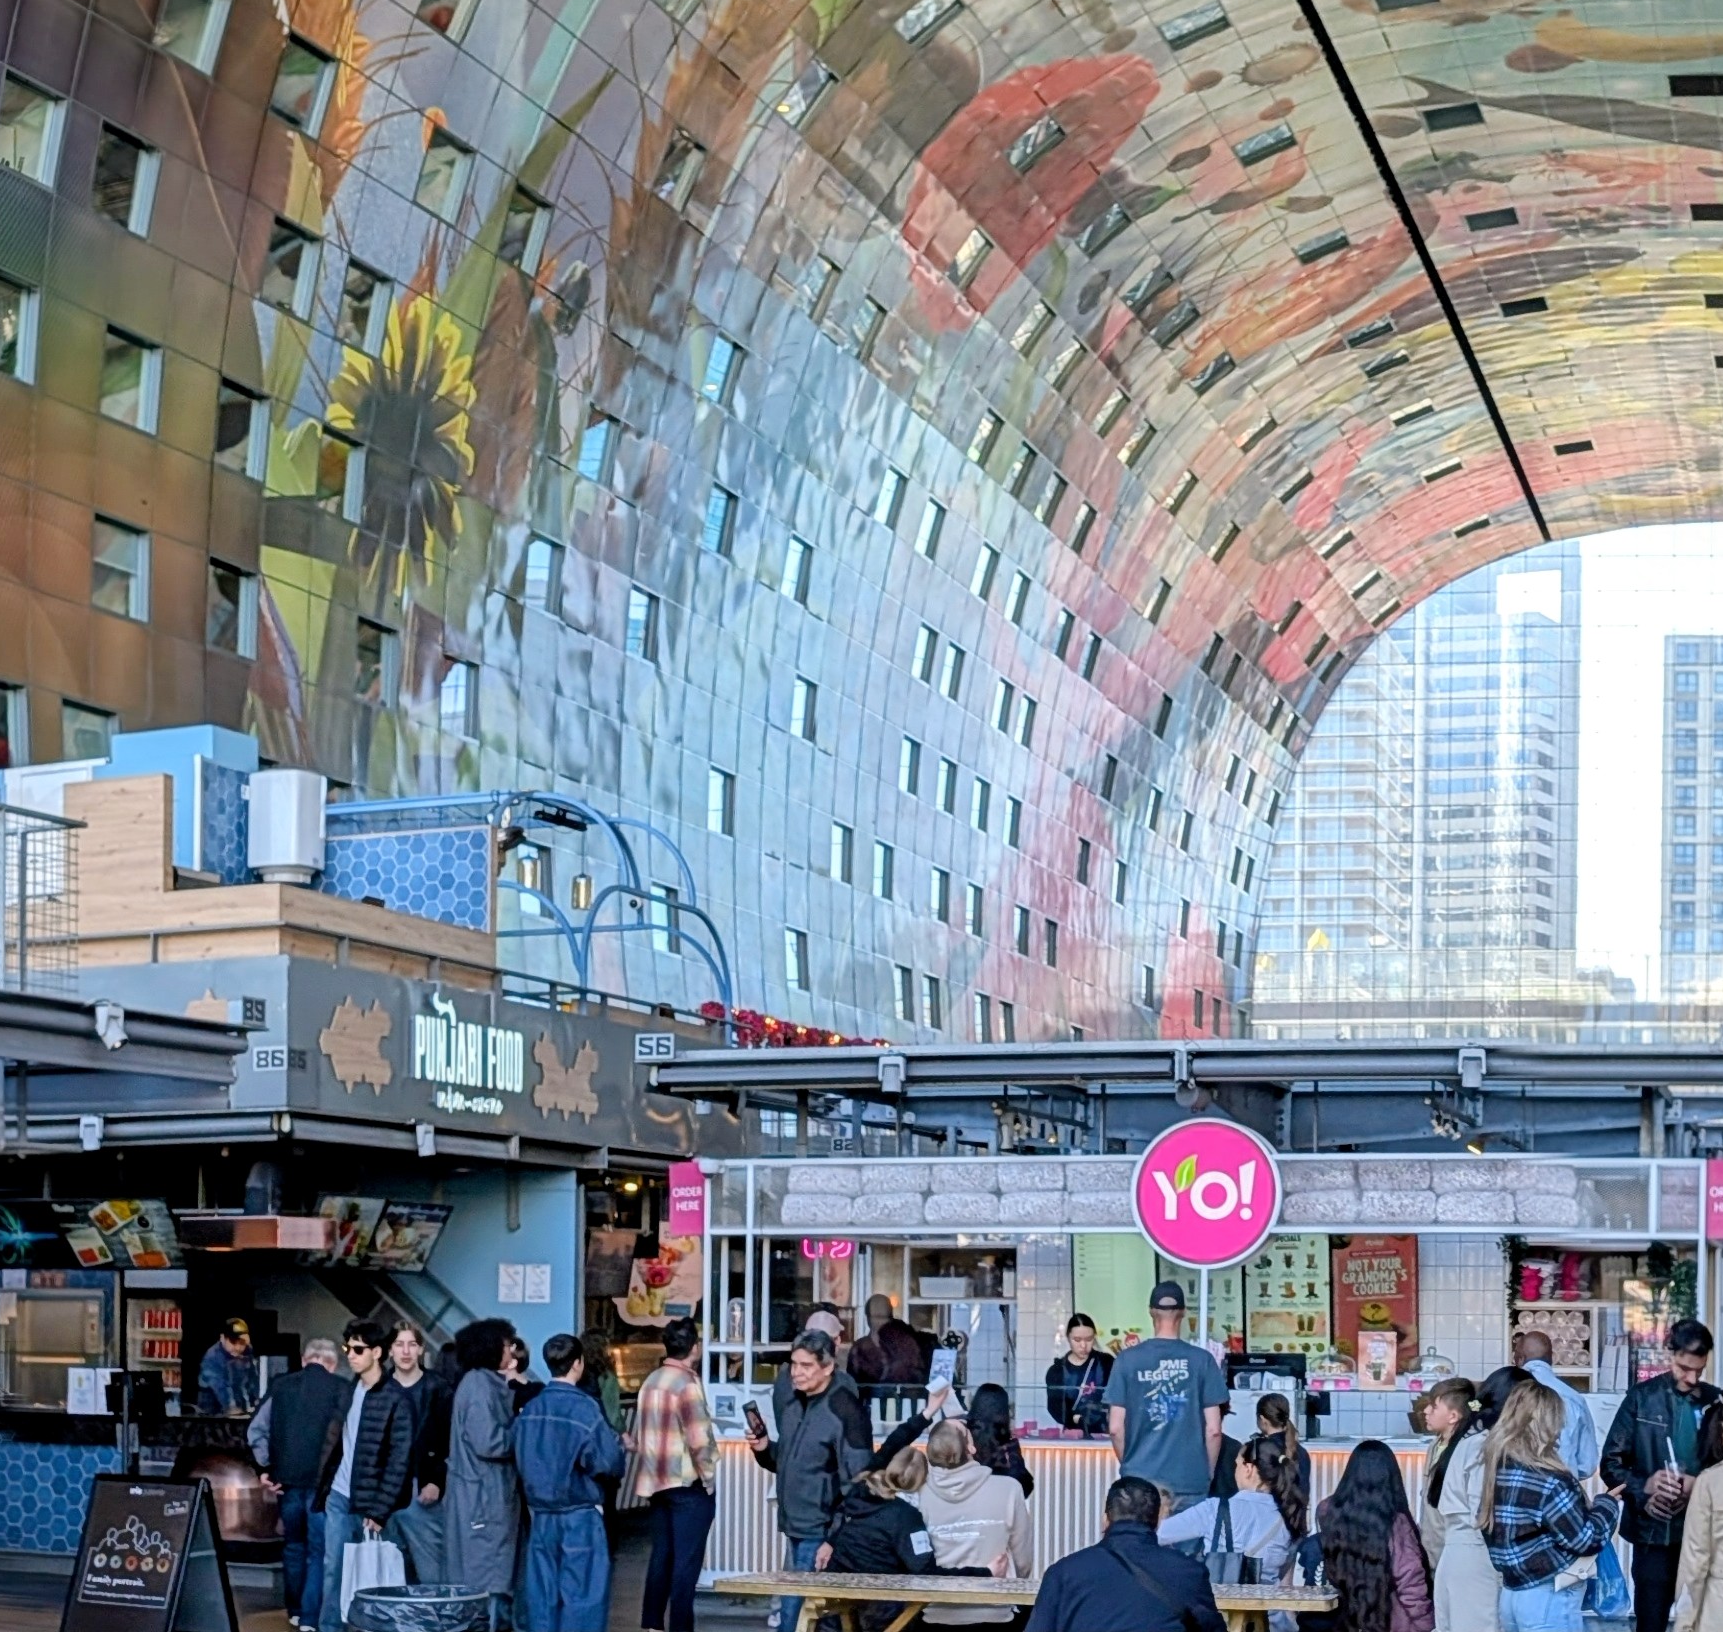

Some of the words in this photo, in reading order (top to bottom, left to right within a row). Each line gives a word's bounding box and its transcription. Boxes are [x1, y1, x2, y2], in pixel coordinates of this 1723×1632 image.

[639, 1037, 671, 1056] 56
[257, 1050, 285, 1068] 86
[415, 1014, 482, 1088] PUNJABI
[487, 1026, 523, 1093] FOOD
[833, 1138, 853, 1151] 82
[672, 1186, 703, 1198] ORDER
[1152, 1157, 1258, 1221] YO!
[676, 1200, 701, 1211] HERE
[1347, 1259, 1369, 1271] NOT
[1372, 1258, 1402, 1270] YOUR
[1342, 1269, 1408, 1284] GRANDMA'S
[1352, 1283, 1397, 1295] COOKIES
[1160, 1359, 1189, 1371] PME
[1137, 1370, 1190, 1382] LEGEND
